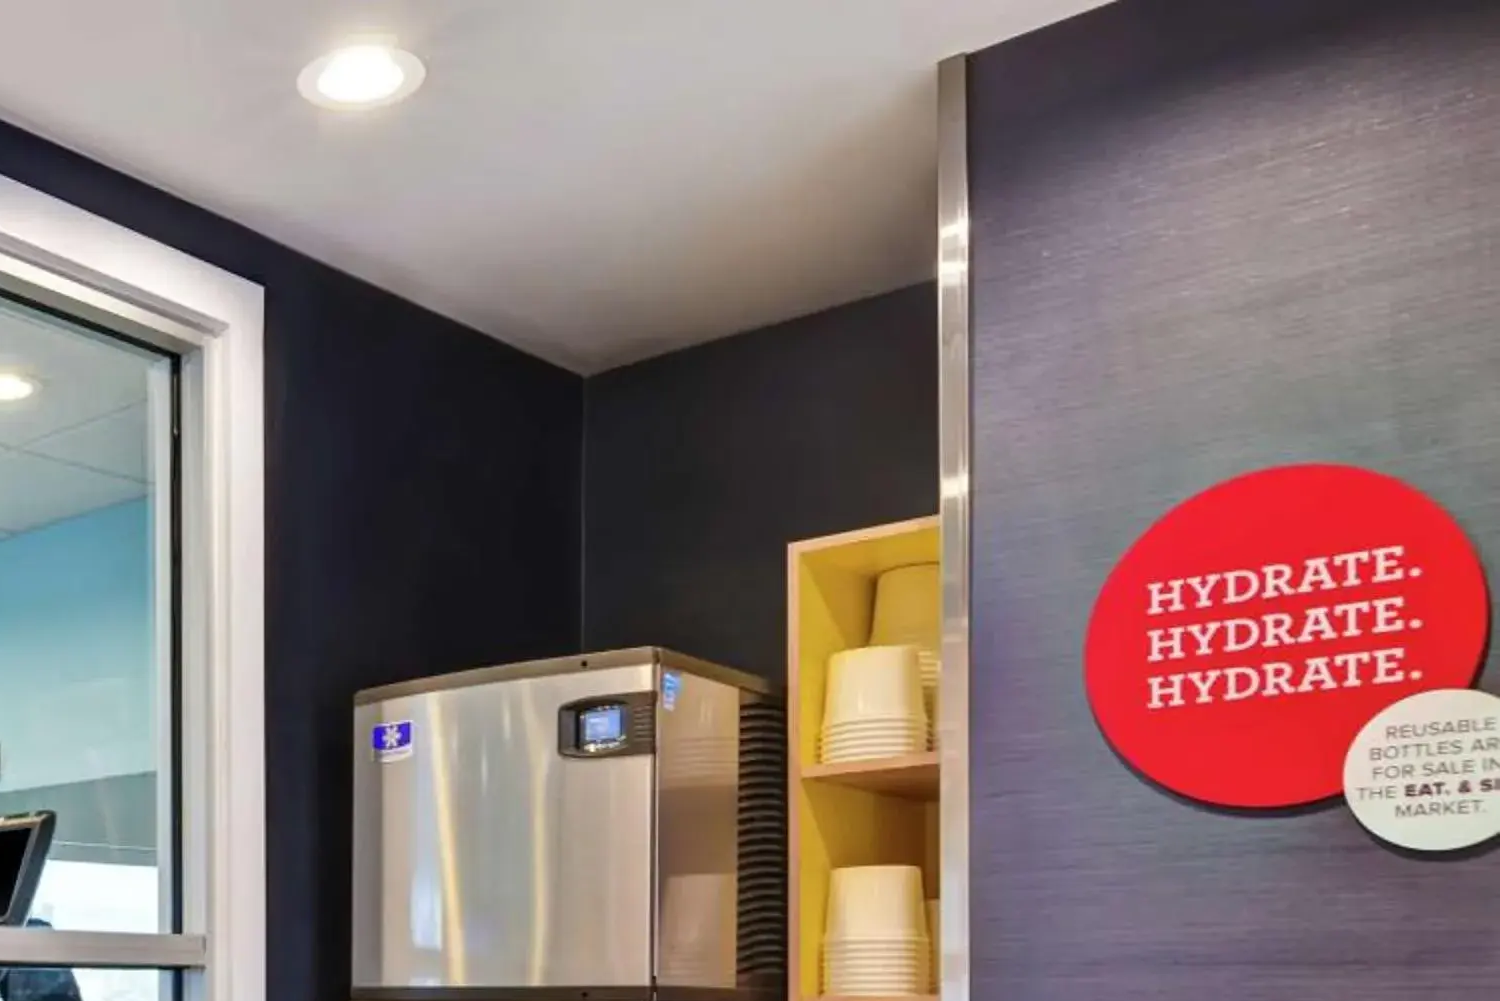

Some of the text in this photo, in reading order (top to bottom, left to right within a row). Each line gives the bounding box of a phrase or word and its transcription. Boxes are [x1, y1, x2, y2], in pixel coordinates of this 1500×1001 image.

[1146, 546, 1423, 616] HYDRATE.
[1146, 597, 1423, 662] HYDRATE.
[1146, 648, 1423, 709] HYDRATE.
[1385, 716, 1497, 740] REUSABLE
[1369, 740, 1463, 761] BOTTLES
[1372, 757, 1500, 780] FOR SALE IN
[1356, 785, 1397, 800] THE
[1404, 781, 1451, 798] EAT.
[1457, 779, 1472, 794] &
[1395, 799, 1488, 818] MARKET.
